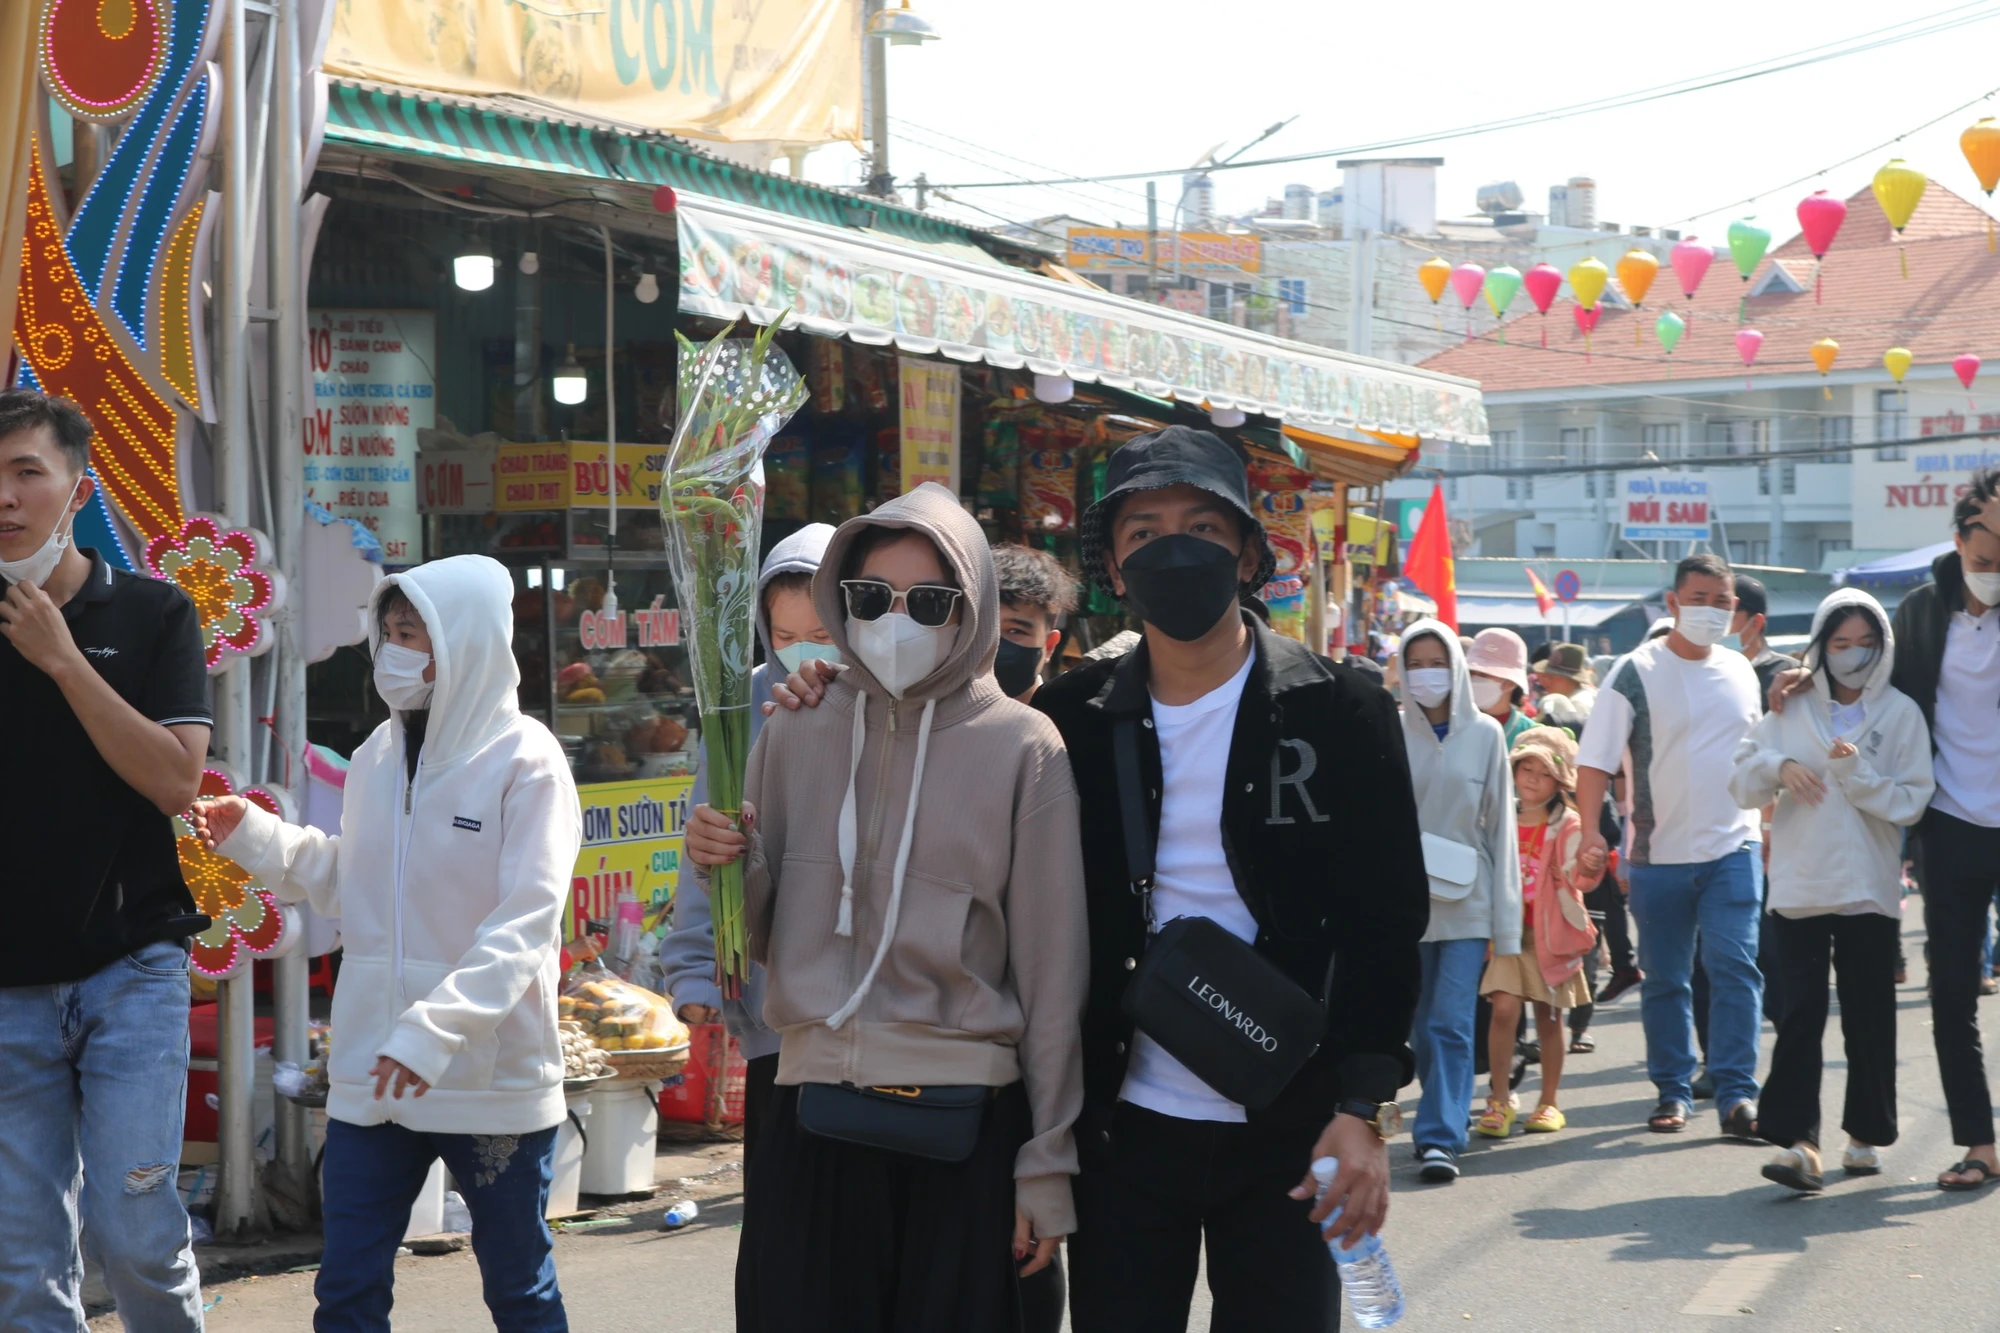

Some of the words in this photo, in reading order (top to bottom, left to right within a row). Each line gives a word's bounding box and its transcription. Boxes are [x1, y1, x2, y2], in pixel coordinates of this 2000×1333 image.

[1628, 495, 1660, 523] NÚI
[1884, 475, 1948, 508] NÚI
[635, 595, 680, 647] TẤM
[1265, 738, 1331, 825] R
[583, 803, 612, 841] ƠM
[618, 793, 664, 837] SƯỜN
[652, 849, 679, 873] CUA
[1187, 975, 1279, 1052] LEONARDO
